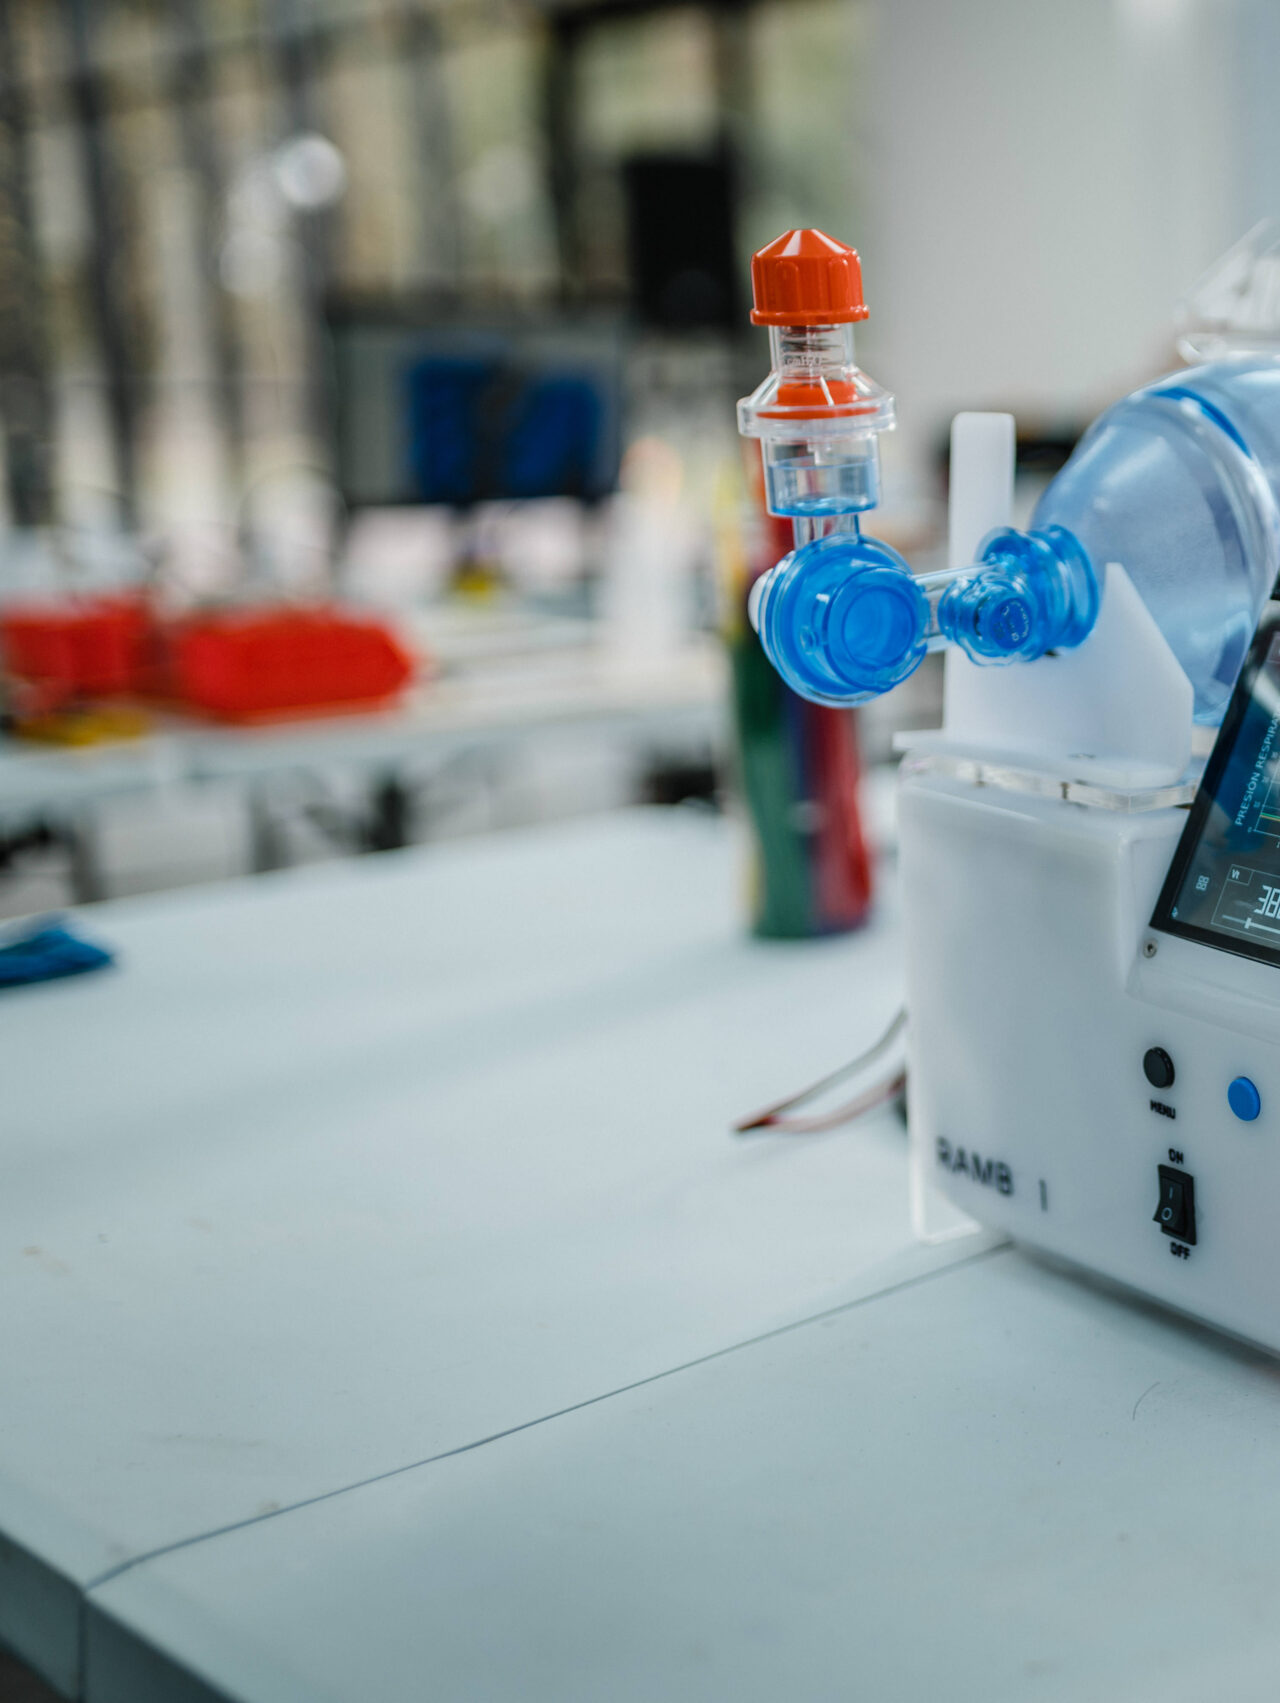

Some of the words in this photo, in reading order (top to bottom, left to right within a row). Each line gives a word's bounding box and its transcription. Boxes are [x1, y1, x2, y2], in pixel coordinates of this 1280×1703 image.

[1234, 771, 1261, 827] PRESIÓN
[1149, 1100, 1176, 1119] MENU
[1168, 1148, 1184, 1164] ON
[936, 1136, 1015, 1197] RAMB
[1170, 1241, 1191, 1260] OFF
